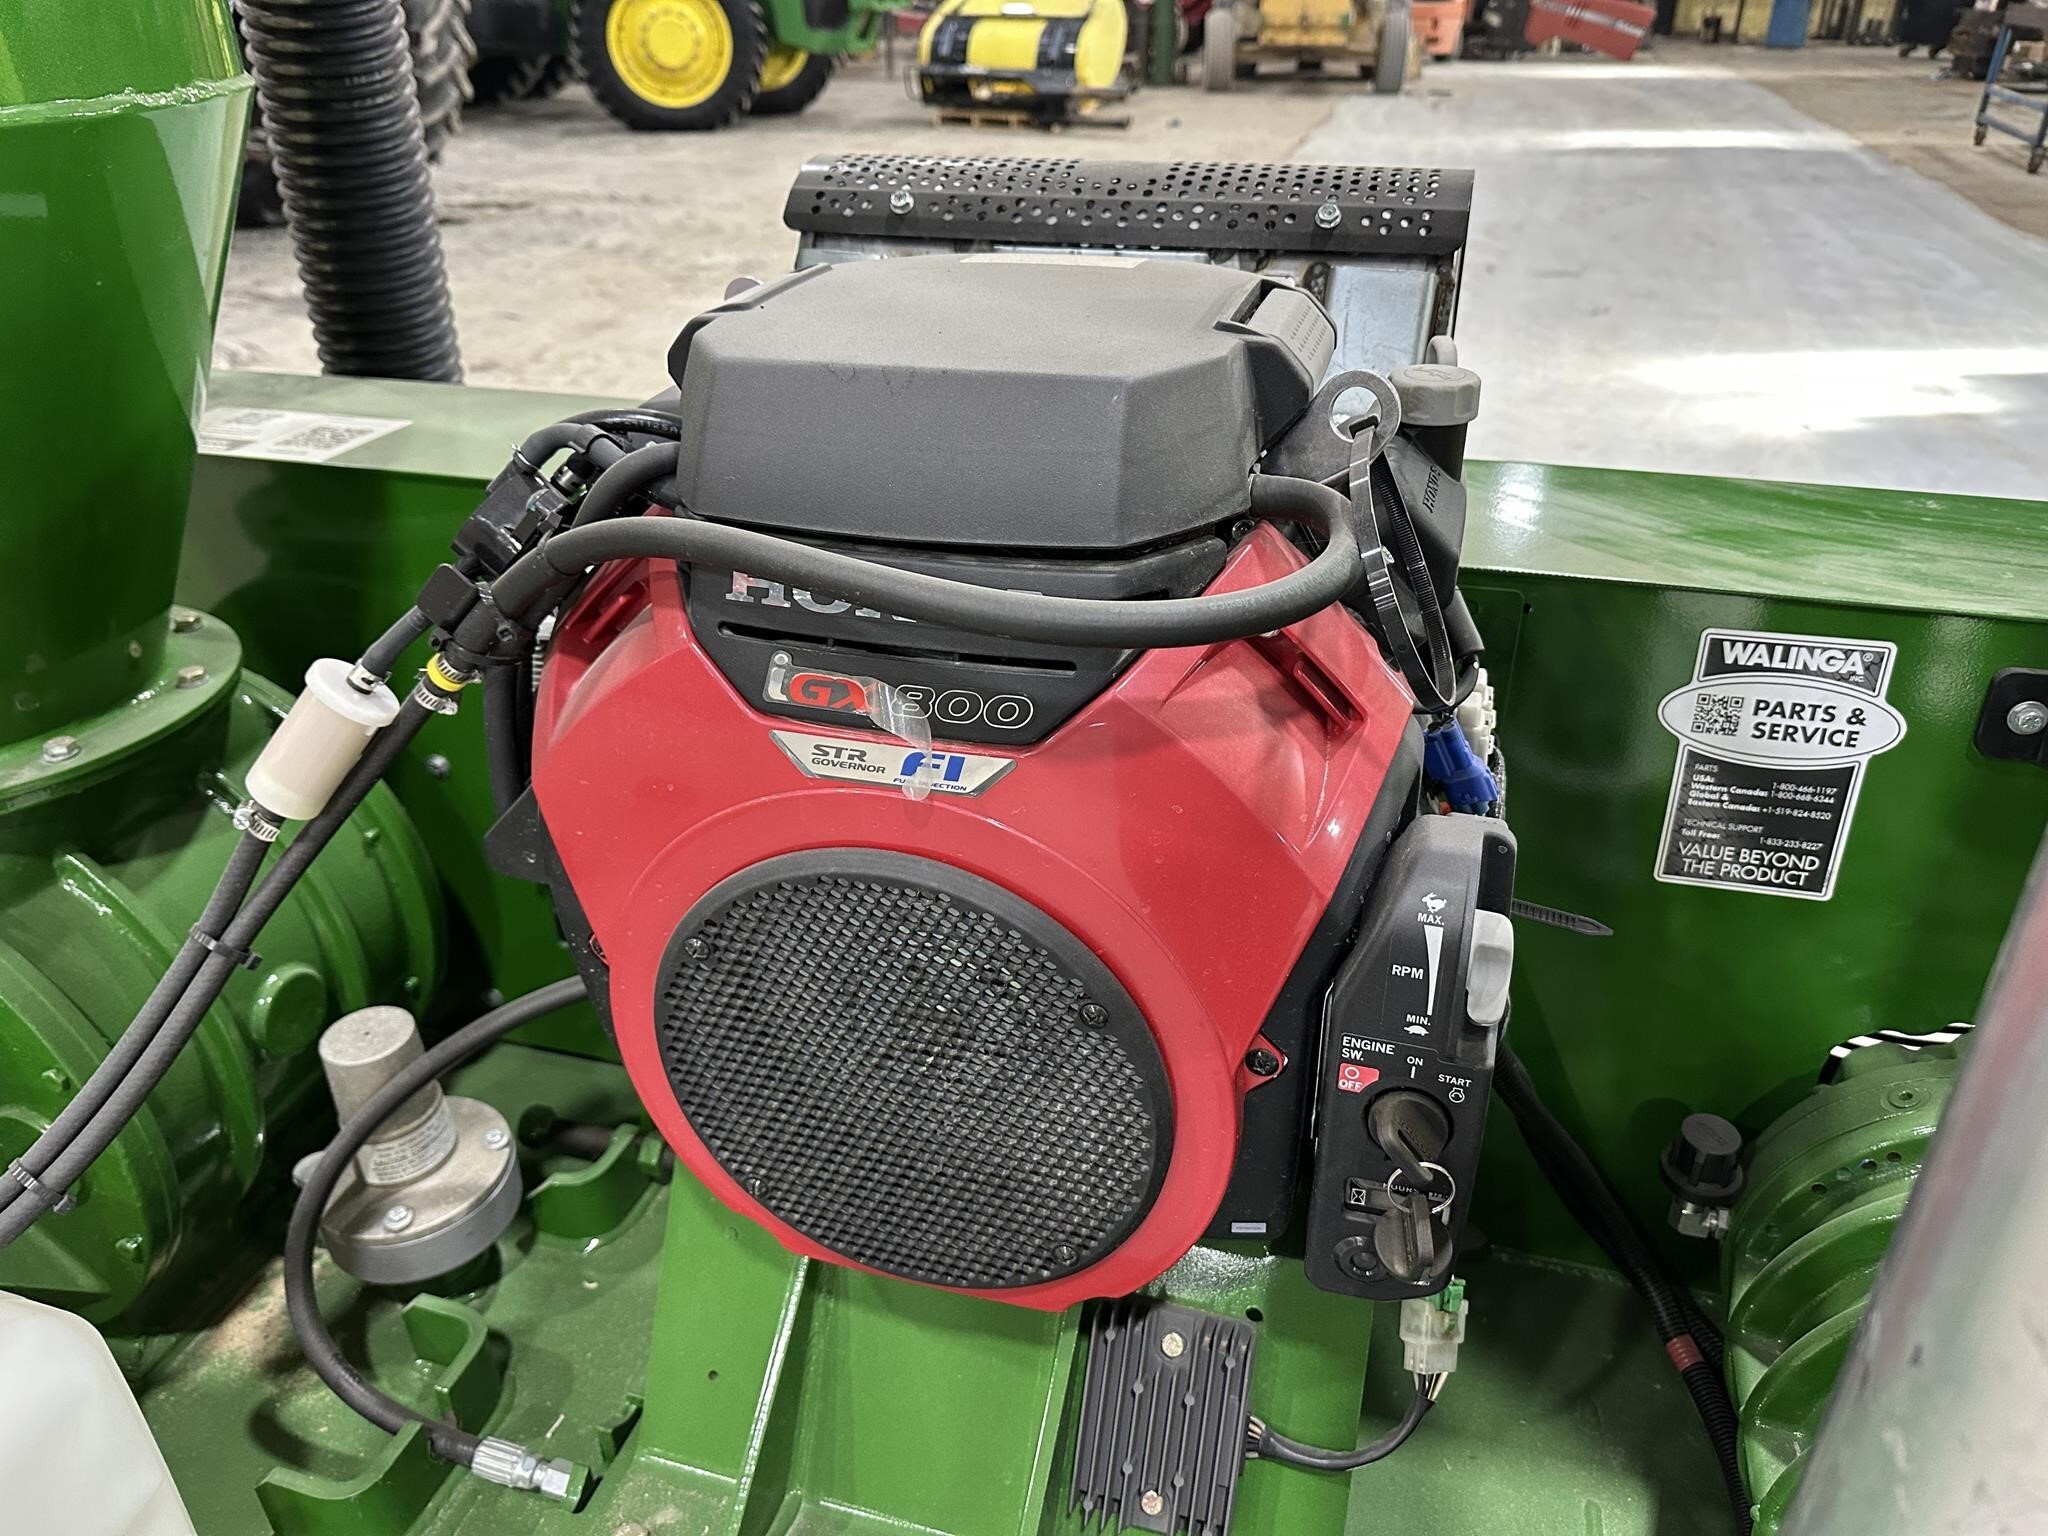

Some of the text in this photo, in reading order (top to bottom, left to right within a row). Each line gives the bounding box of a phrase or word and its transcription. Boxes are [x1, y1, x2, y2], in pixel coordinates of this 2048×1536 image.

[1722, 641, 1866, 675] WALINGA
[891, 684, 1034, 729] 800
[1752, 699, 1868, 727] PARTS &
[1751, 722, 1861, 749] SERVICE
[811, 743, 867, 763] STR
[811, 757, 886, 775] GOVERNOR
[900, 751, 966, 783] FI
[1694, 763, 1719, 773] PARTS
[1690, 782, 1835, 804] Western Canada: 1-800-668-6344
[1692, 774, 1839, 795] USA: 1-800-466-1197
[1688, 790, 1729, 801] Global &
[1687, 799, 1721, 810] Eastern
[1722, 801, 1761, 813] Canada:
[1683, 818, 1764, 834] TECHNICAL SUPPORT
[1681, 828, 1697, 837] Toll
[1759, 837, 1824, 851] 1-833-233-8227
[1678, 841, 1820, 871] VALUE BEYOND
[1682, 858, 1810, 887] THE PRODUCT
[1417, 912, 1445, 926] MAX.
[1391, 964, 1425, 980] RPM
[1406, 1014, 1431, 1026] MIN.
[1342, 1036, 1396, 1055] ENGINE
[1341, 1048, 1364, 1062] SW.
[1406, 1056, 1424, 1067] ON
[1338, 1079, 1363, 1092] OFF
[1437, 1074, 1472, 1088] START
